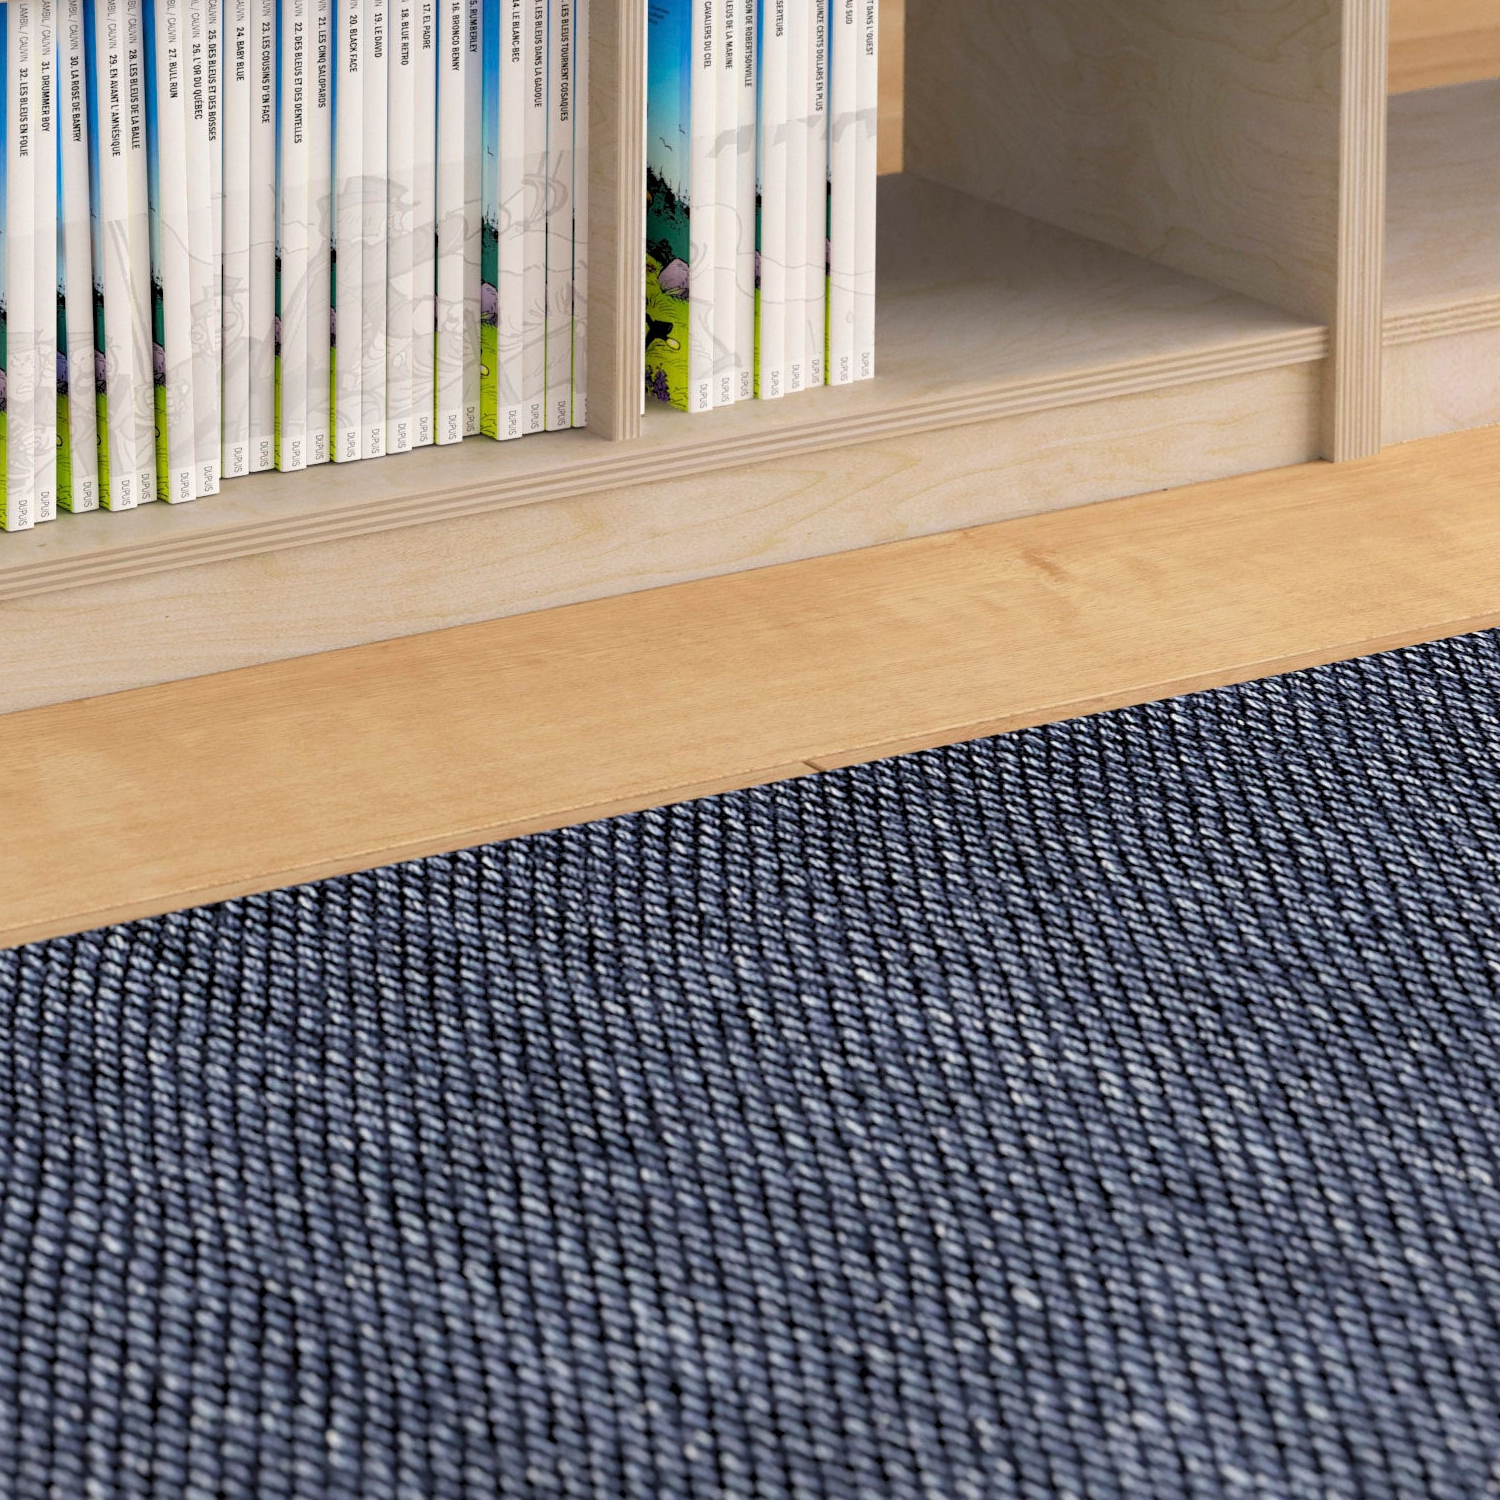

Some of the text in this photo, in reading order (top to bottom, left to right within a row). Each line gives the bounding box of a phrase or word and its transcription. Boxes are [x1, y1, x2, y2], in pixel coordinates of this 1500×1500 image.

[510, 11, 521, 19] LE
[559, 3, 570, 17] LES
[702, 0, 713, 39] CAVALIERS
[743, 15, 754, 24] DE
[864, 5, 876, 25] DANS
[510, 20, 521, 63] BLANC-BEC
[559, 18, 570, 42] BLEUS
[702, 40, 713, 51] DU
[814, 25, 826, 48] CENTS
[864, 26, 875, 56] L'OUEST
[234, 27, 246, 82] 24. BABY BLUE
[559, 42, 570, 80] TOURNENT
[702, 52, 713, 69] CIEL
[743, 26, 754, 88] ROBERTSONVILLE
[814, 48, 825, 80] DOLLARS
[40, 61, 51, 132] 31. DRUMMER BOY
[191, 44, 206, 120] 26. L'OR DU QUÉBEC
[293, 22, 304, 144] 22. DES BLEUS ET DES DENTELLES
[814, 81, 825, 91] EN
[108, 54, 124, 157] 29. EN AVANT L'AMNÉSIQUE
[558, 82, 570, 122] COSAQUES
[814, 92, 825, 111] PLUS
